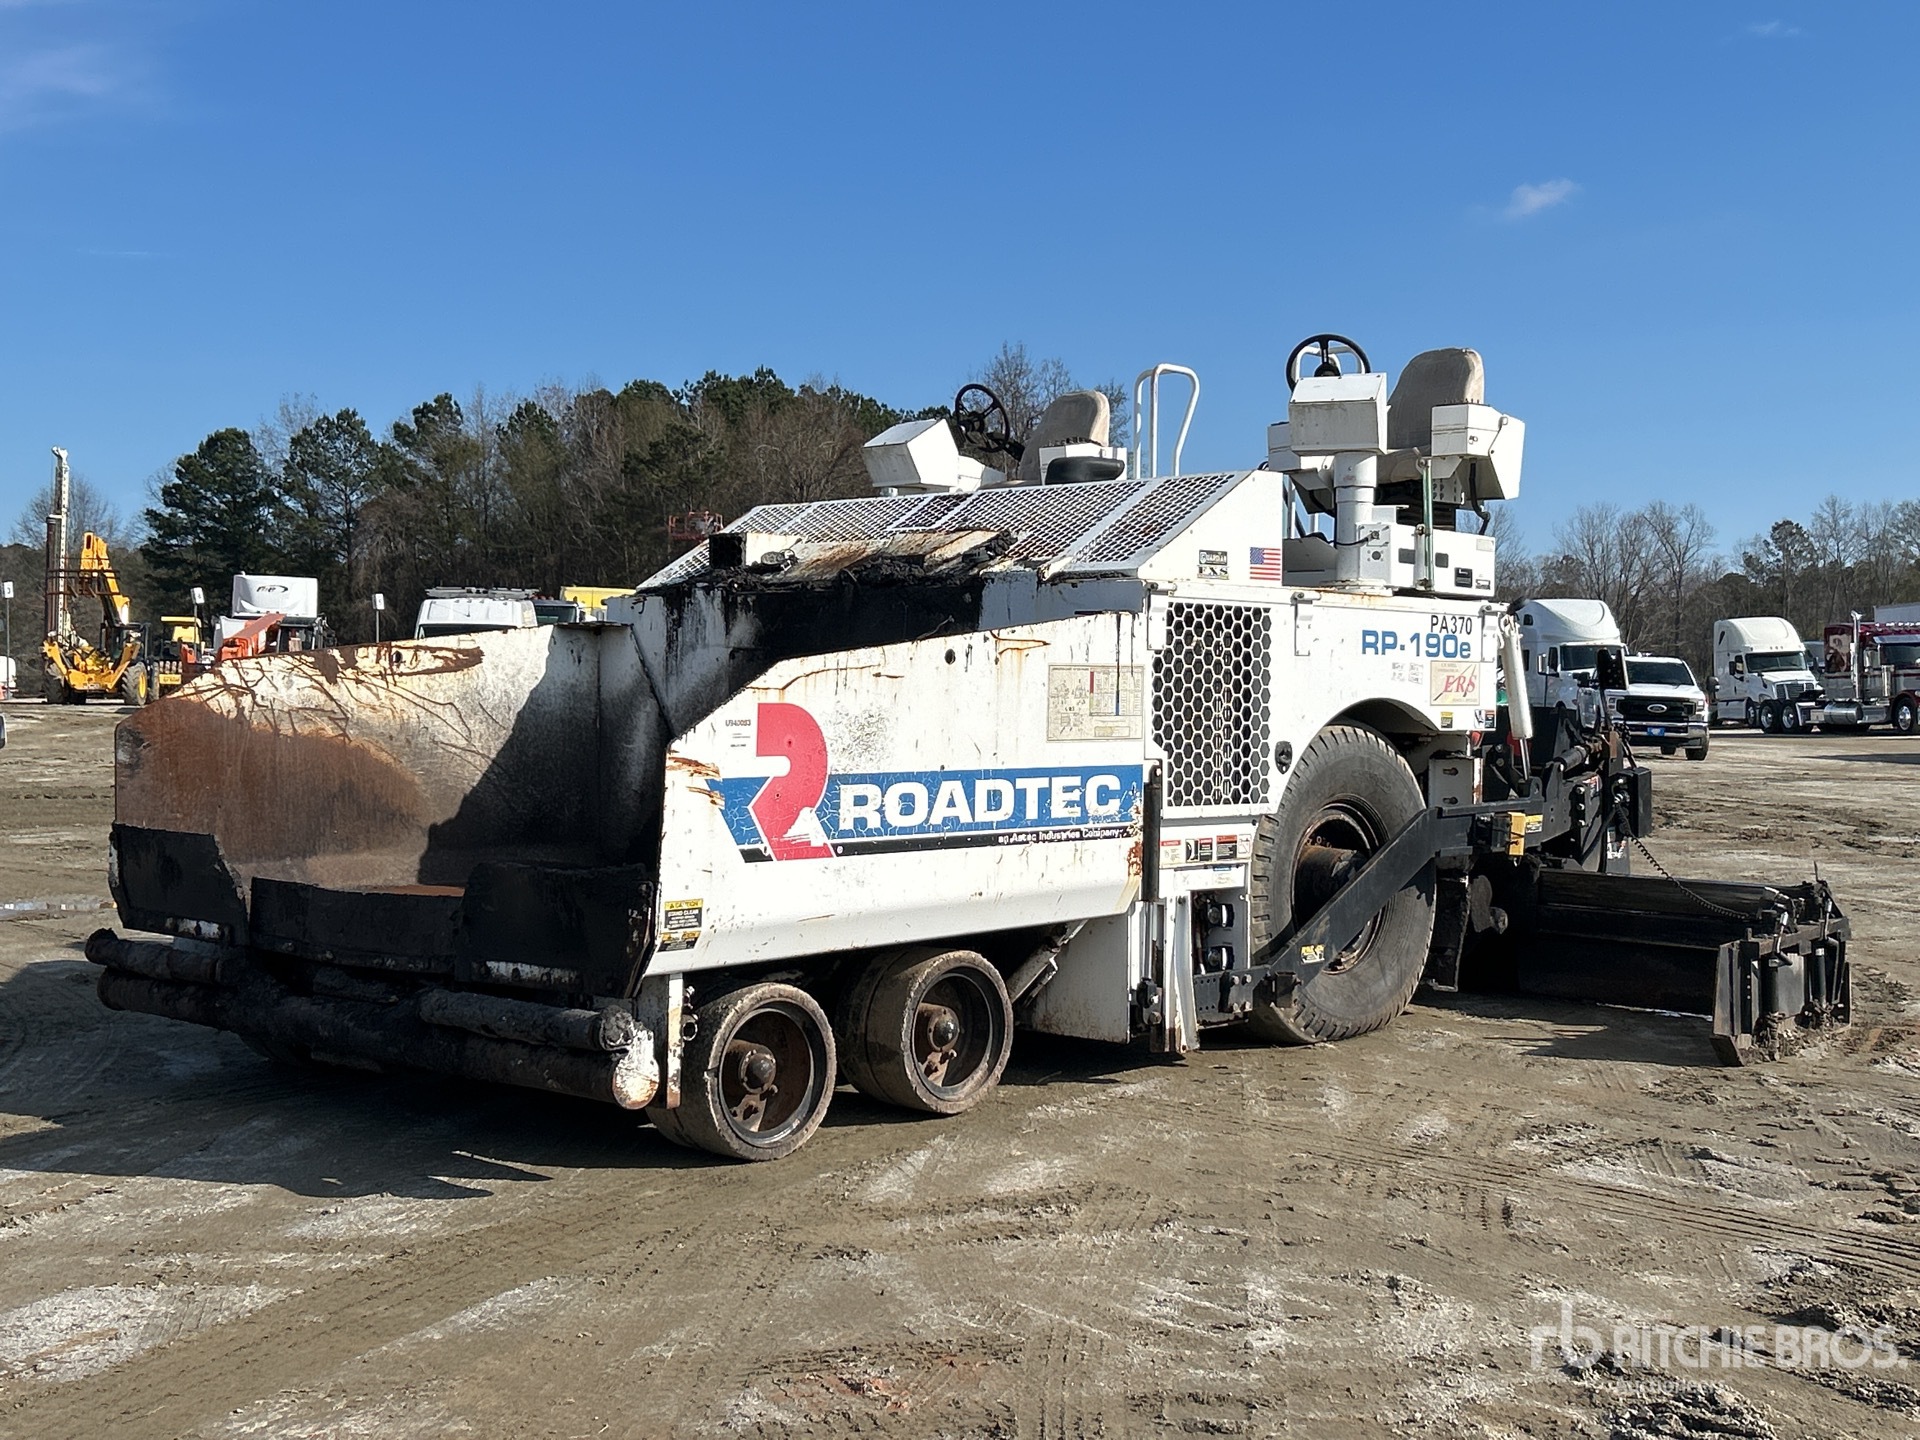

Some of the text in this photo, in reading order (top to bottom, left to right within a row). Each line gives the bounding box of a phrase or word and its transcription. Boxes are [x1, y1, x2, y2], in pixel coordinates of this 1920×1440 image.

[1430, 614, 1473, 635] PA370
[1361, 629, 1472, 659] RP-190e
[1443, 674, 1478, 693] ERS
[838, 774, 1122, 831] ROADTEC
[1010, 833, 1037, 843] Astec
[1038, 830, 1081, 842] Industries
[1082, 827, 1120, 839] Company
